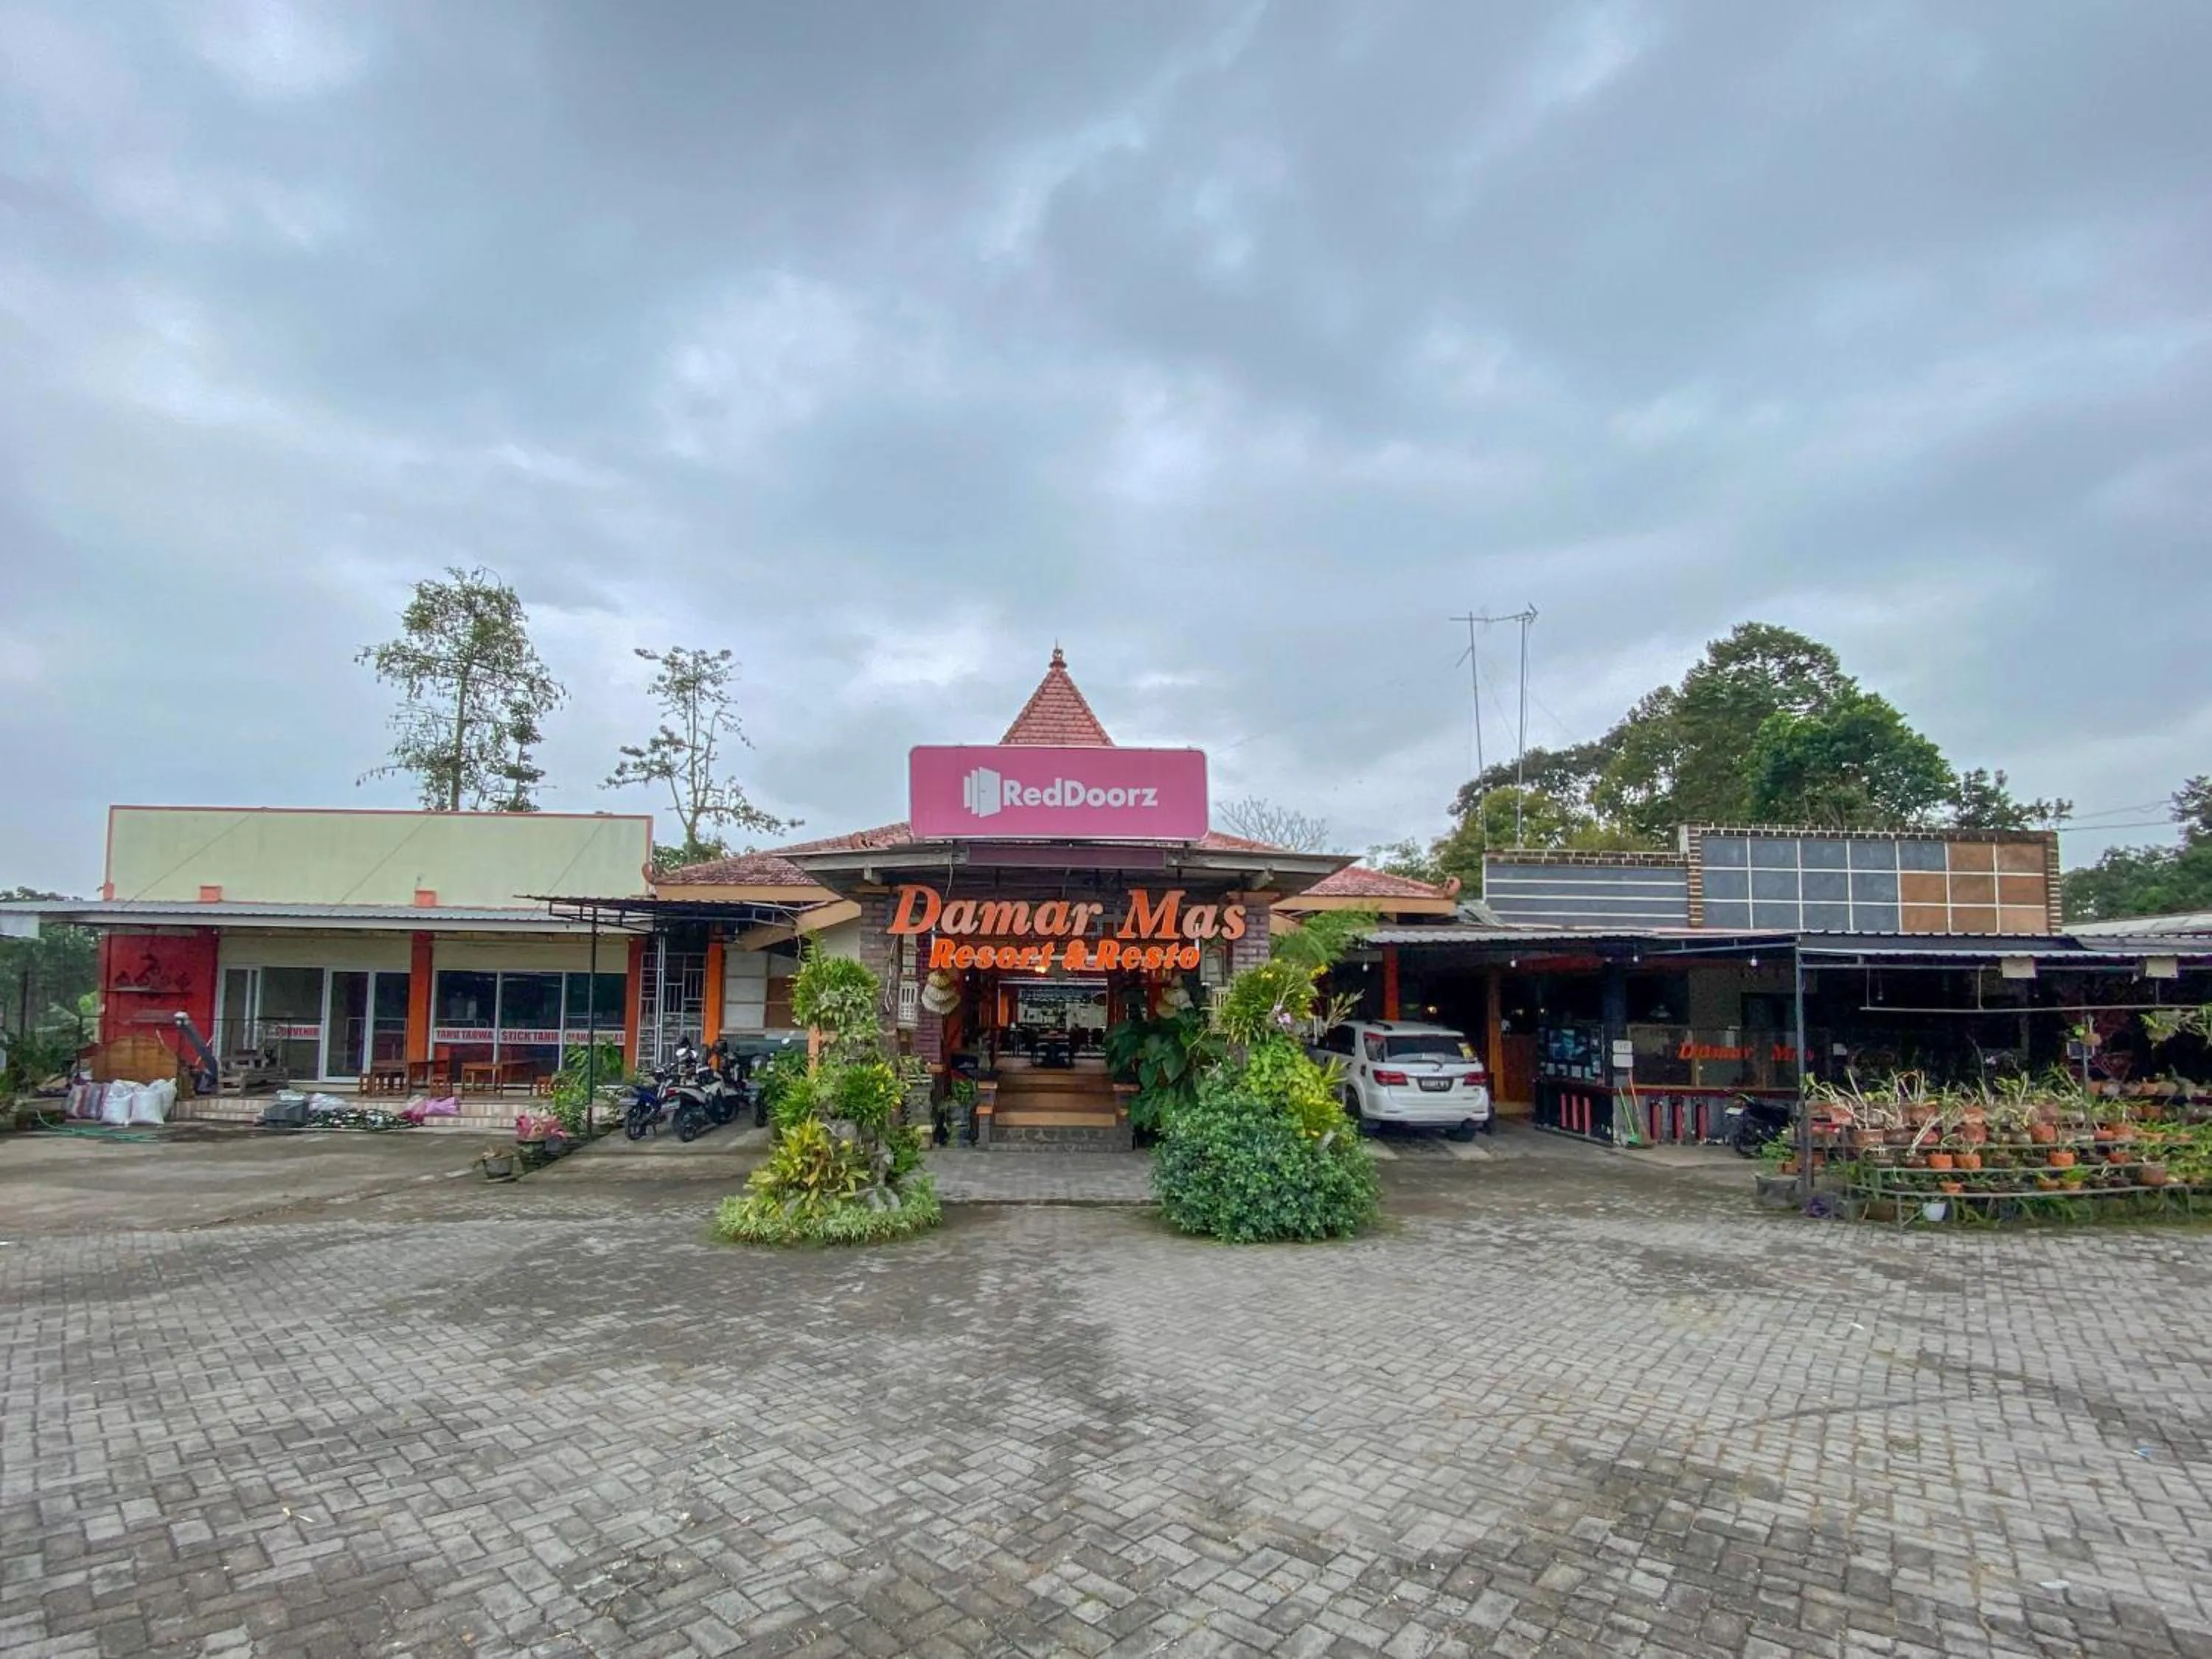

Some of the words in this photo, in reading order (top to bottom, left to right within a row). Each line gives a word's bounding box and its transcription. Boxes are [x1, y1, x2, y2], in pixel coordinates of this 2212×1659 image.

[1003, 778, 1158, 807] RedDoorz
[886, 884, 1105, 936] Damar
[1116, 888, 1247, 941] Mas
[928, 938, 1055, 970] Resort
[1061, 939, 1089, 970] &
[1093, 939, 1200, 970] Resto
[501, 1031, 531, 1042] STICK
